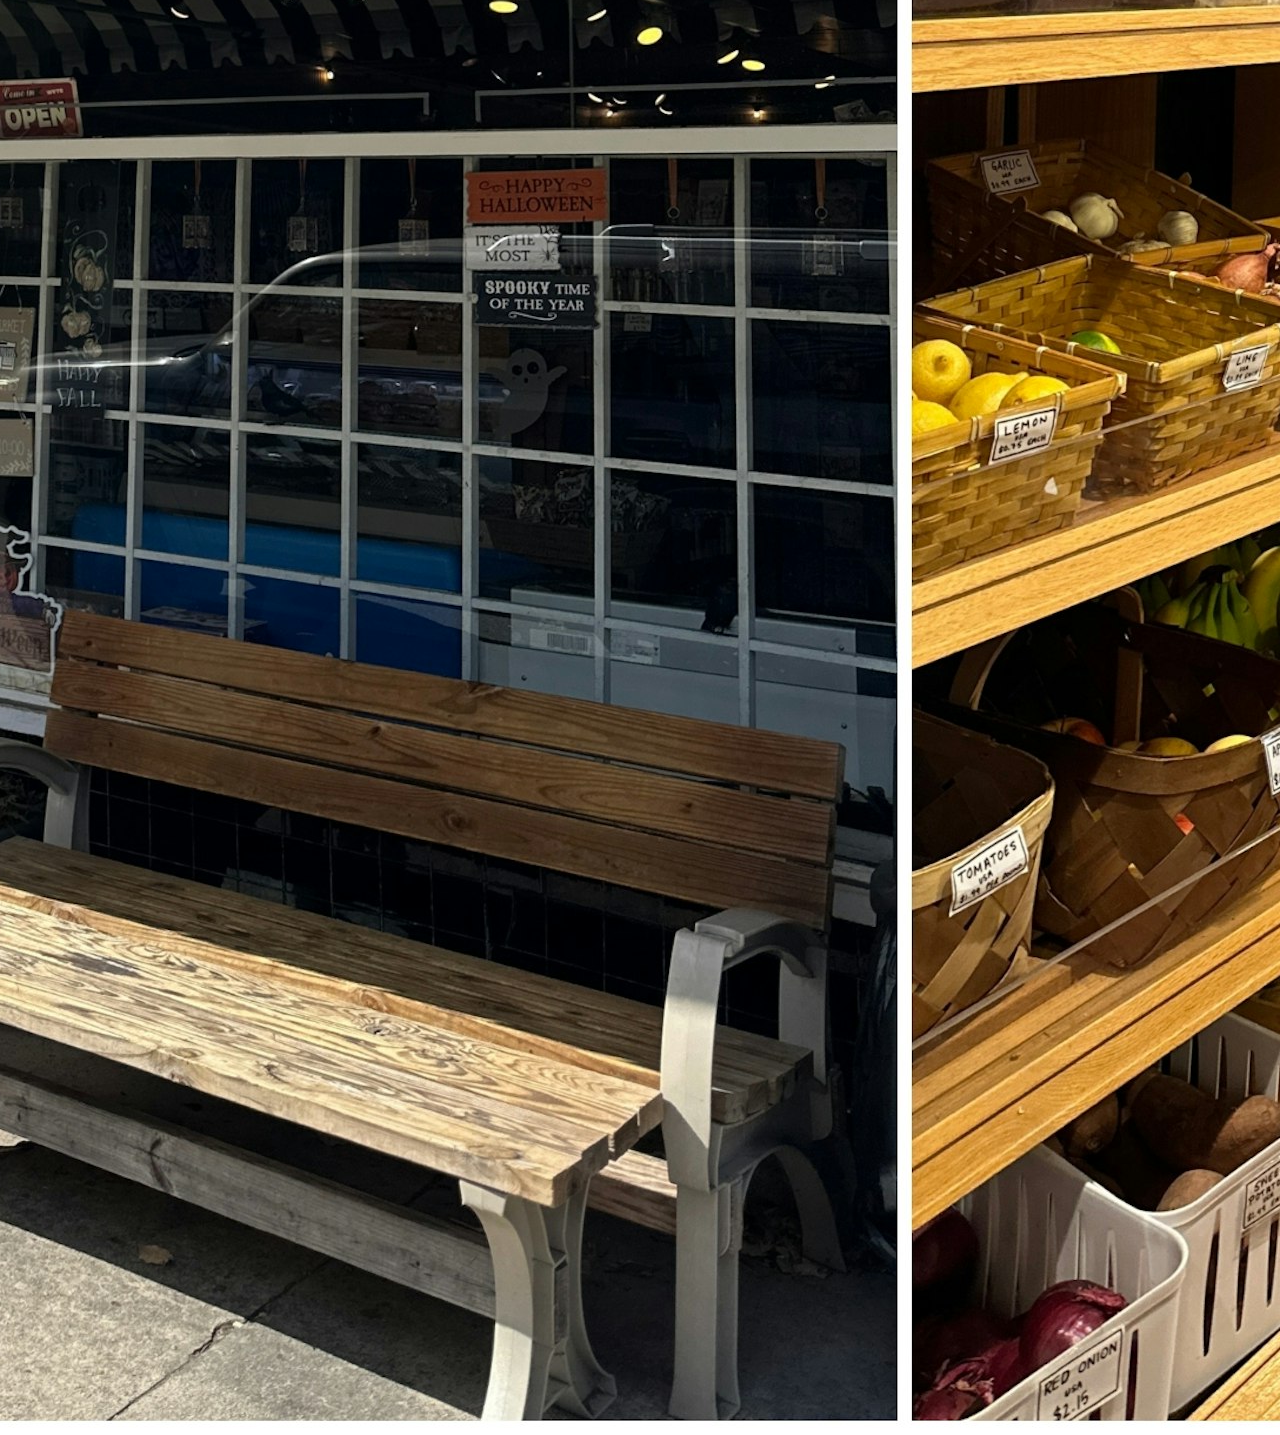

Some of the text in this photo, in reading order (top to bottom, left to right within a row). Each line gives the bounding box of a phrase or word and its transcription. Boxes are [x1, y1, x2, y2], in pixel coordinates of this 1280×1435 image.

[4, 101, 67, 132] OPEN
[989, 158, 1023, 173] GARLIC
[505, 177, 566, 194] HAPPY
[479, 195, 594, 214] HALLOWEEN
[485, 249, 531, 263] MOST
[484, 280, 591, 296] SPOOKY TIME
[489, 297, 585, 312] OF THE YEAR
[1236, 352, 1259, 367] LIME
[57, 358, 103, 384] HAPPY
[56, 387, 102, 408] FALL
[1002, 414, 1050, 438] LEMON
[1026, 434, 1049, 448] EACH
[957, 840, 1018, 884] TOMATOES
[977, 870, 994, 886] USA
[1042, 1342, 1119, 1398] RED ONION
[1062, 1380, 1083, 1399] USA
[1052, 1389, 1089, 1421] $2.15
